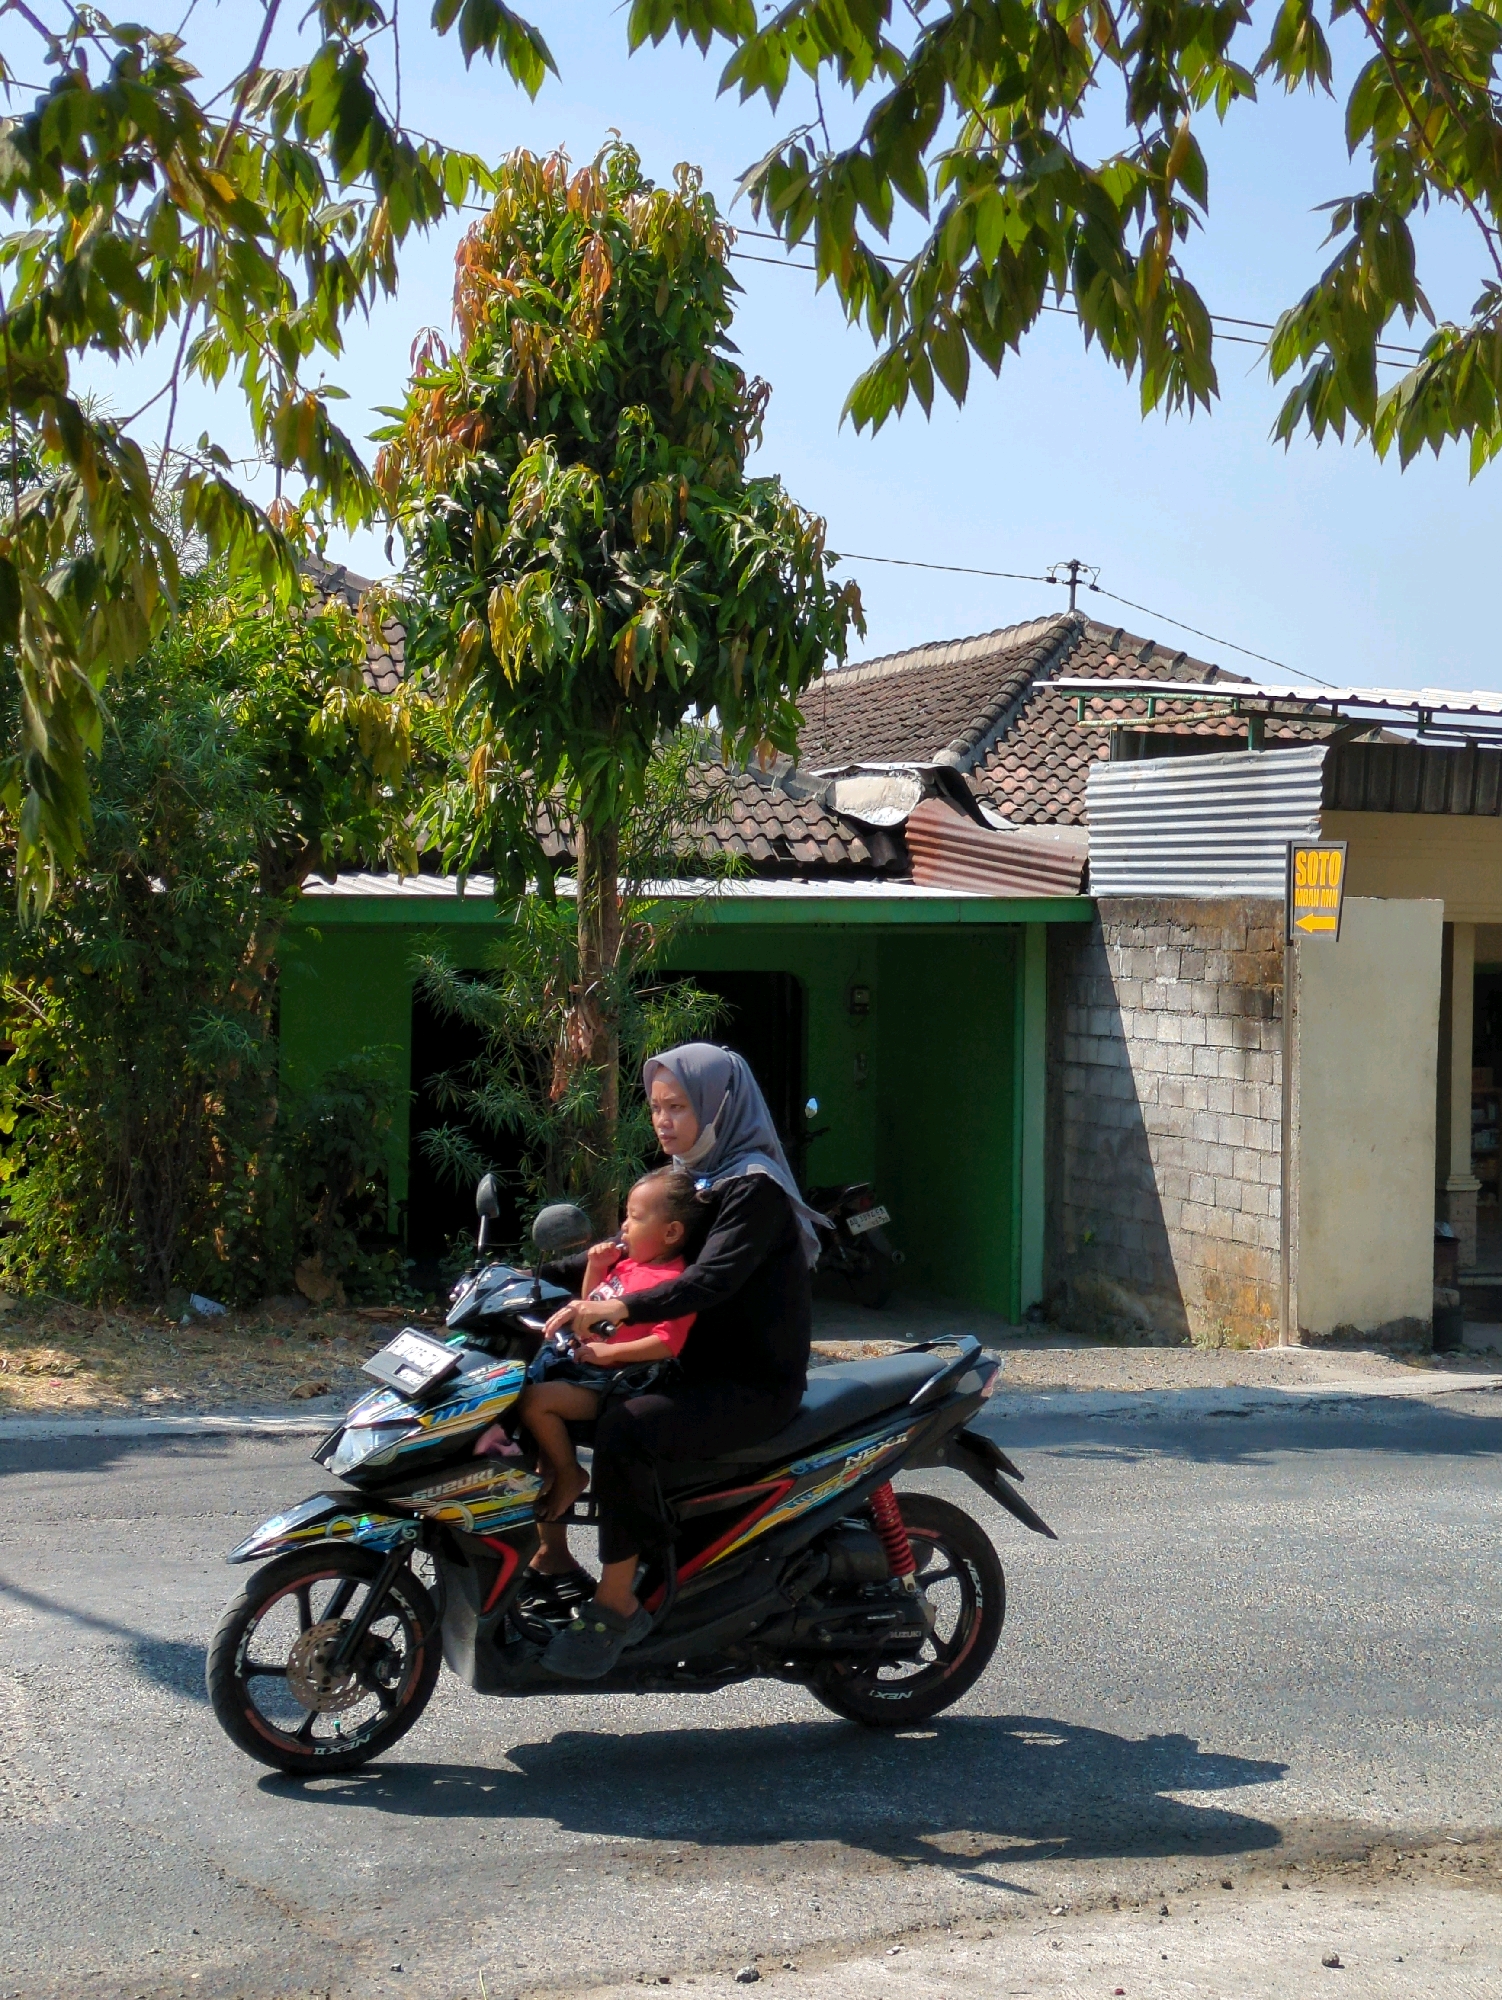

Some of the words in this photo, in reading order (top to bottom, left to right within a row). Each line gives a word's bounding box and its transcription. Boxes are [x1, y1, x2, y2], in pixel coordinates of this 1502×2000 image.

[1295, 850, 1342, 887] SOTO
[1295, 888, 1320, 908] MBAH
[411, 1467, 495, 1500] SUZUKI
